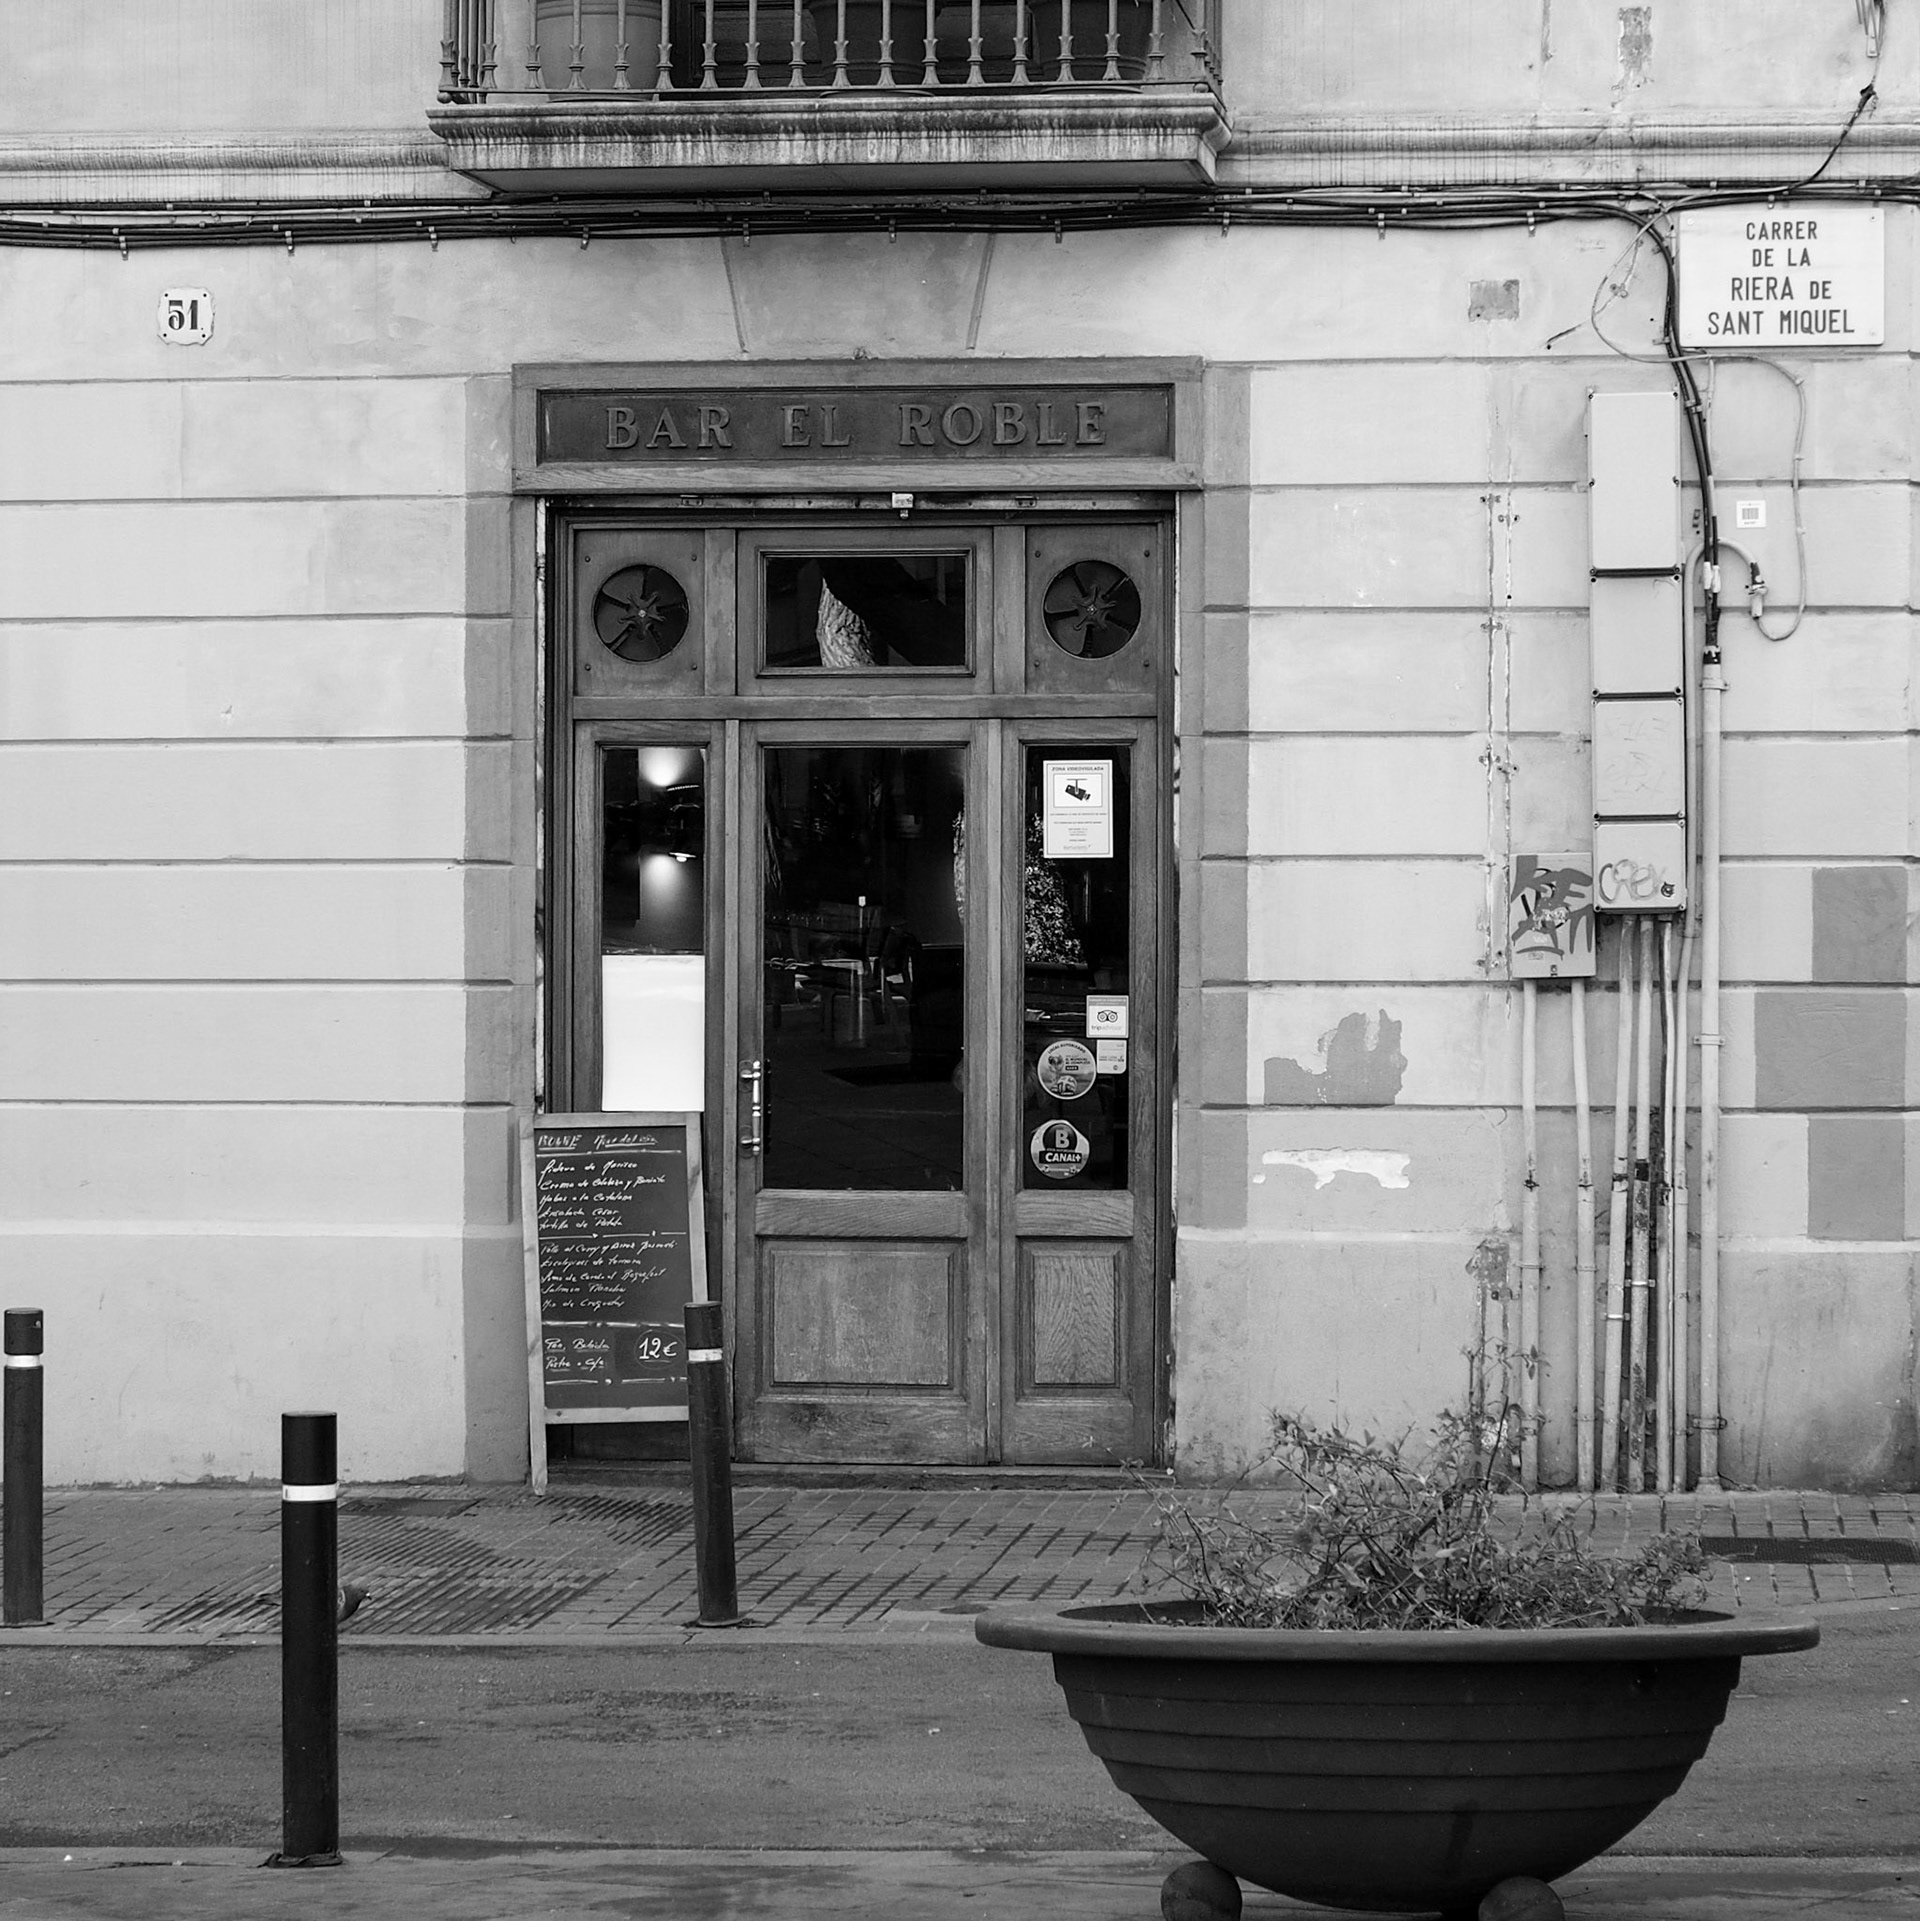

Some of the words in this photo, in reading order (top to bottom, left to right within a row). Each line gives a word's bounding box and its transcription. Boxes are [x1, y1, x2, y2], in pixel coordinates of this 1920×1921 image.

[1746, 221, 1818, 240] CARRER
[1752, 248, 1774, 267] DE
[1787, 248, 1811, 267] LA
[1731, 276, 1794, 301] RIERA
[1810, 280, 1832, 300] DE
[168, 299, 198, 330] 51
[1708, 310, 1764, 335] SANT
[1779, 309, 1855, 335] MIQUEL
[605, 405, 733, 449] BAR
[781, 404, 851, 449] EL
[899, 401, 1107, 447] ROBLE
[1055, 1129, 1070, 1149] B
[1045, 1152, 1081, 1162] CANAL+
[584, 1162, 597, 1171] de
[540, 1179, 575, 1190] Crema
[578, 1179, 590, 1188] de
[623, 1180, 633, 1190] y
[579, 1192, 590, 1202] la
[576, 1220, 589, 1229] de
[601, 1244, 611, 1255] y
[592, 1257, 604, 1266] de
[565, 1273, 577, 1283] de
[562, 1299, 575, 1308] de
[639, 1337, 679, 1360] 12€
